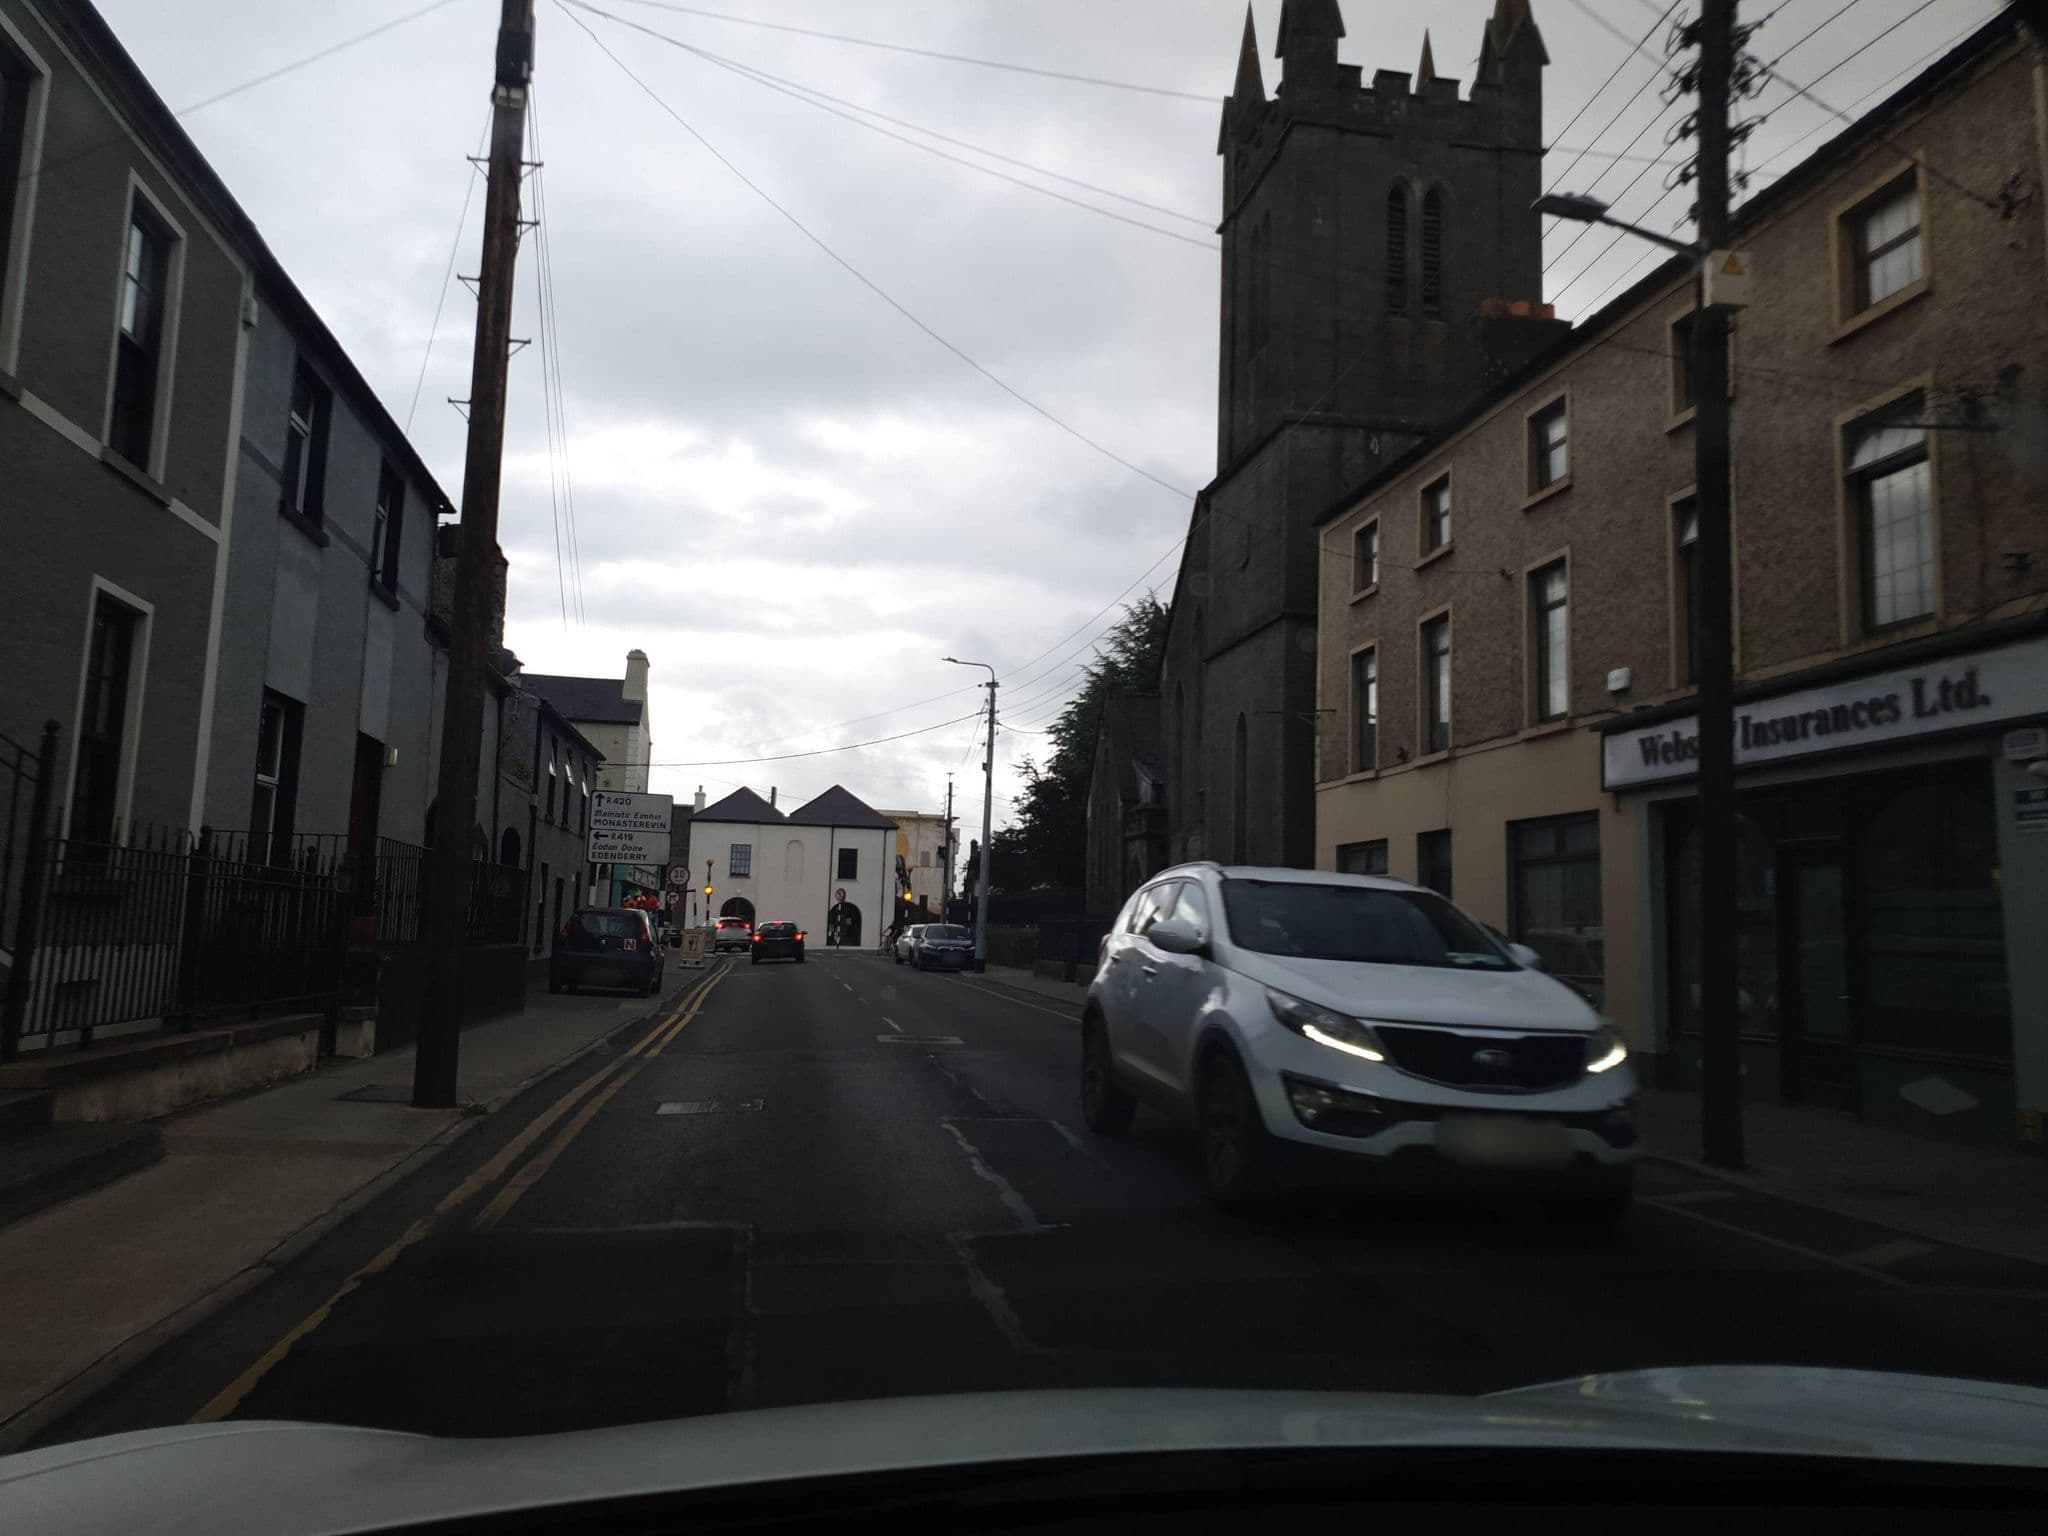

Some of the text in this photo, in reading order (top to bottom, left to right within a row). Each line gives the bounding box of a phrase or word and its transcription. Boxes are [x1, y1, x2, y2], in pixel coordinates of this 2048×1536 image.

[1741, 691, 1901, 750] Insurances
[1910, 668, 1991, 719] Ltd.
[594, 818, 667, 829] MONASTEREVIN
[592, 852, 648, 861] EDENDERRY
[674, 869, 685, 879] 30
[625, 939, 635, 949] N
